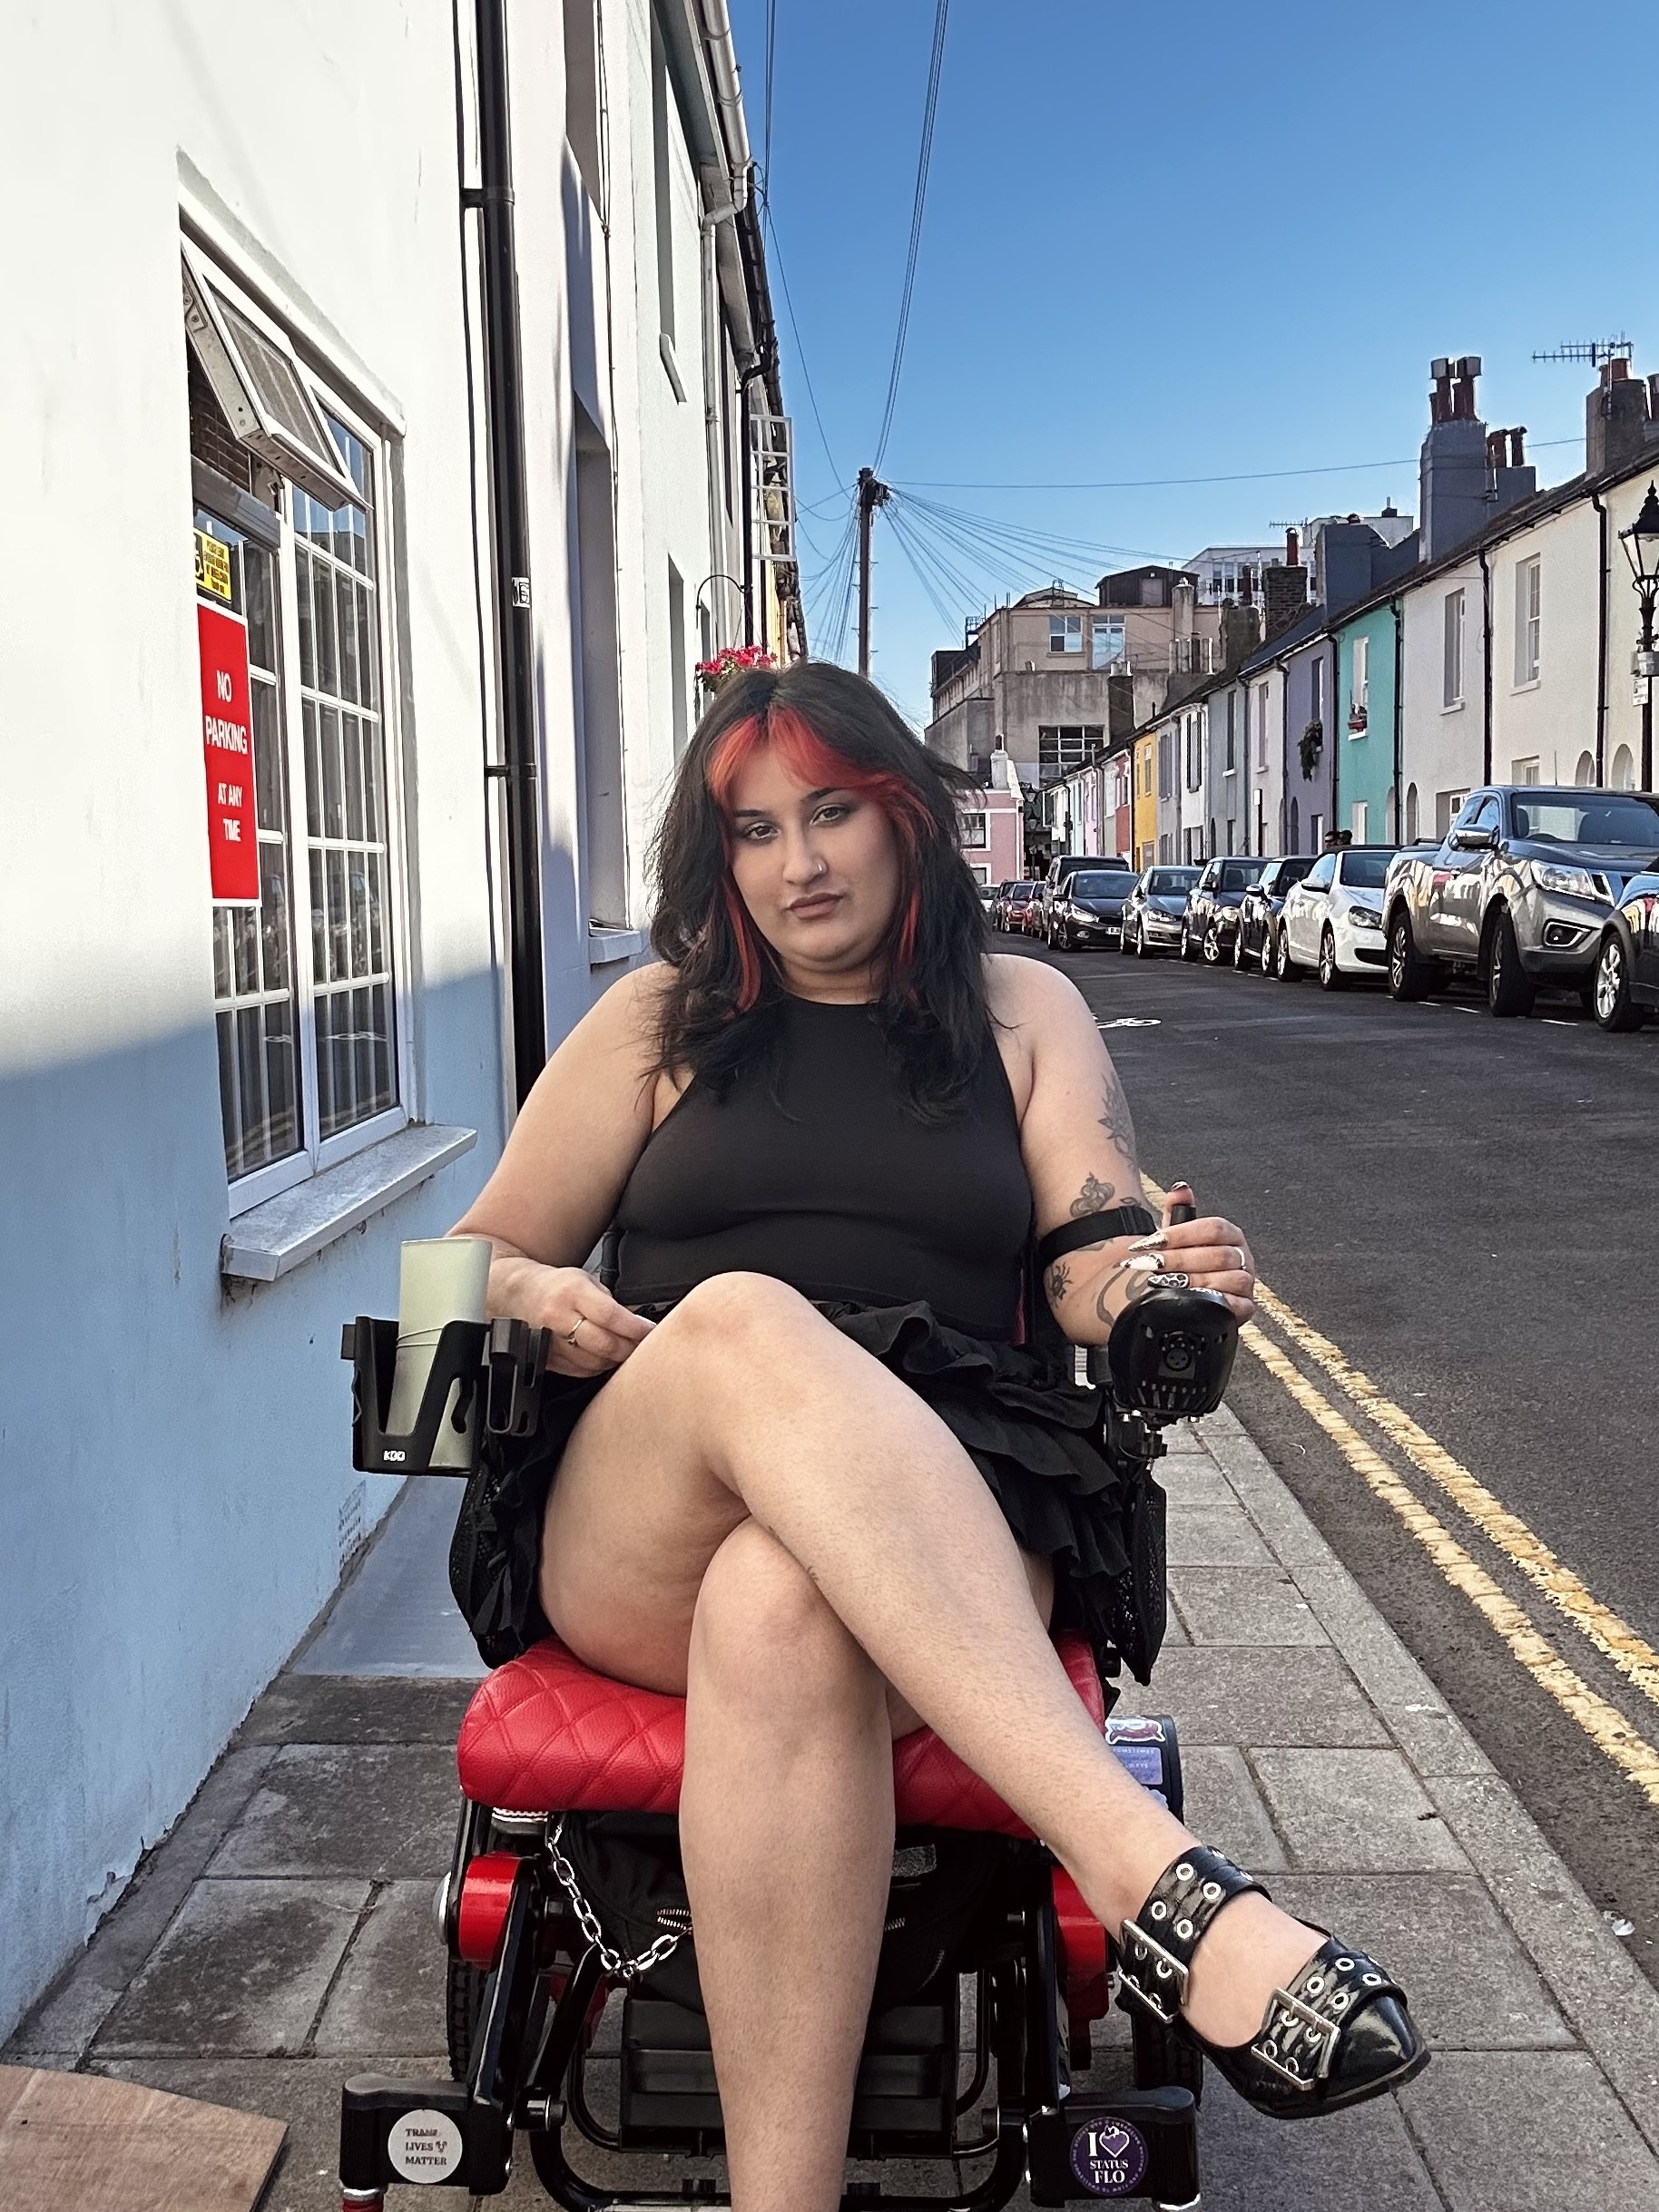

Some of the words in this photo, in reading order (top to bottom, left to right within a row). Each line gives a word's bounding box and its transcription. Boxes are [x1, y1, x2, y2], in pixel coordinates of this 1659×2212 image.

[215, 669, 232, 703] NO
[205, 714, 248, 755] PARKING
[217, 782, 227, 806] AT
[228, 784, 243, 808] ANY
[222, 817, 241, 842] TIME
[405, 2141, 434, 2151] LIVES
[1087, 2131, 1098, 2158] I
[405, 2156, 447, 2166] MATTER
[1089, 2158, 1129, 2170] STATUS
[1094, 2169, 1125, 2184] FLO
